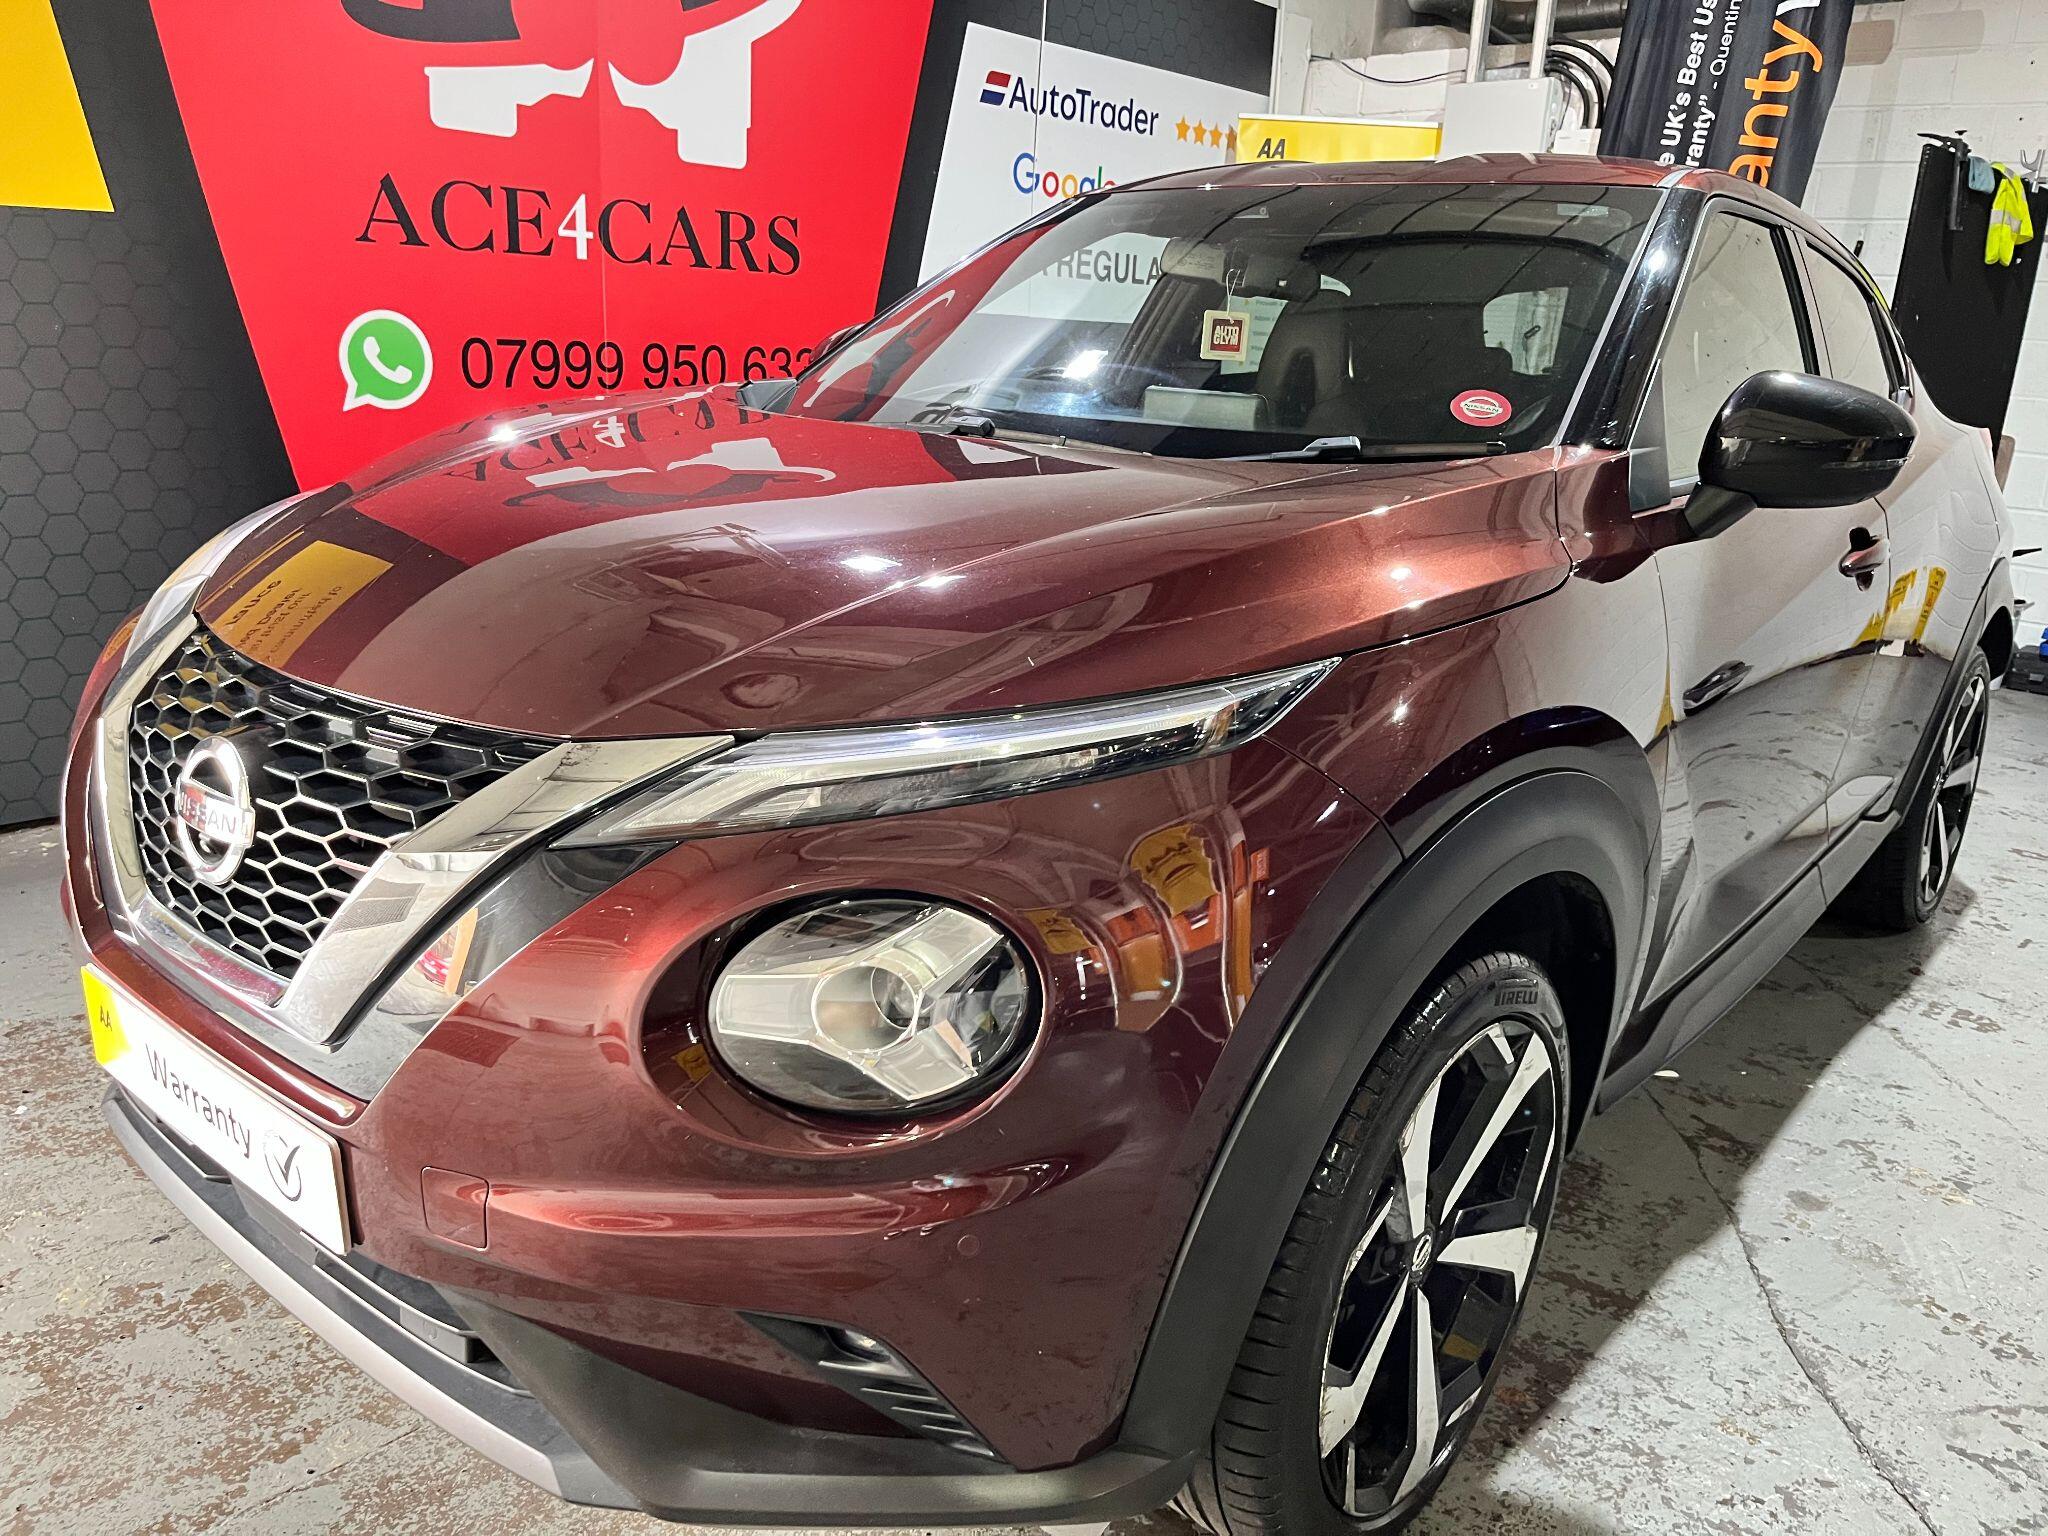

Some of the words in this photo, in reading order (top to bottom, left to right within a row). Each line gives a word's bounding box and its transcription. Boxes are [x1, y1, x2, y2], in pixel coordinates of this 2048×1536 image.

[1677, 32, 1708, 86] Best
[1710, 0, 1743, 76] Quentin
[1009, 77, 1159, 136] AutoTrader
[1728, 0, 1823, 188] anty
[1257, 138, 1286, 159] AA
[355, 172, 801, 276] ACE4CARS
[1213, 333, 1239, 346] GLYM
[1214, 325, 1239, 337] AUTO
[461, 337, 624, 390] 07999
[642, 343, 727, 390] 950
[1463, 402, 1499, 413] NISSAN
[100, 1005, 112, 1032] AA
[1494, 978, 1539, 1006] PIRELLI
[145, 1043, 250, 1159] Warranty
